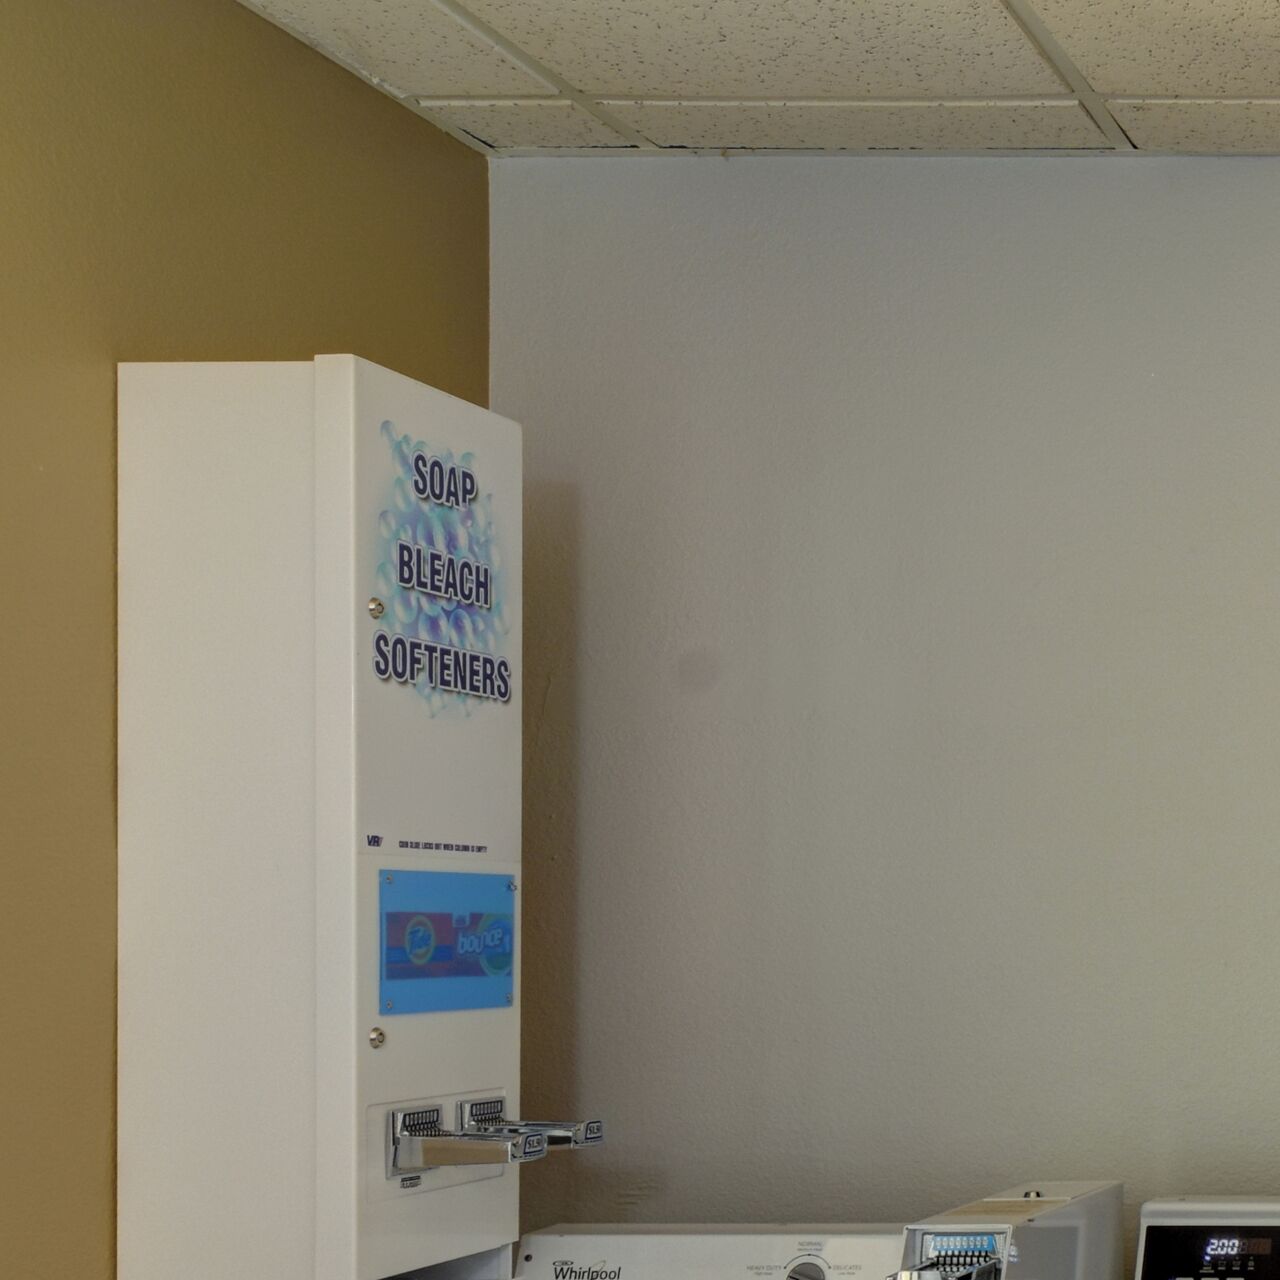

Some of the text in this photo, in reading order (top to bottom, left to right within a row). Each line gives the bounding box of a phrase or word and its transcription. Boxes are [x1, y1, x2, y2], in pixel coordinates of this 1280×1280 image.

[413, 452, 476, 507] SOAP
[399, 542, 490, 606] BLEACH
[374, 632, 510, 700] SOFTENERS
[456, 927, 503, 955] bounce
